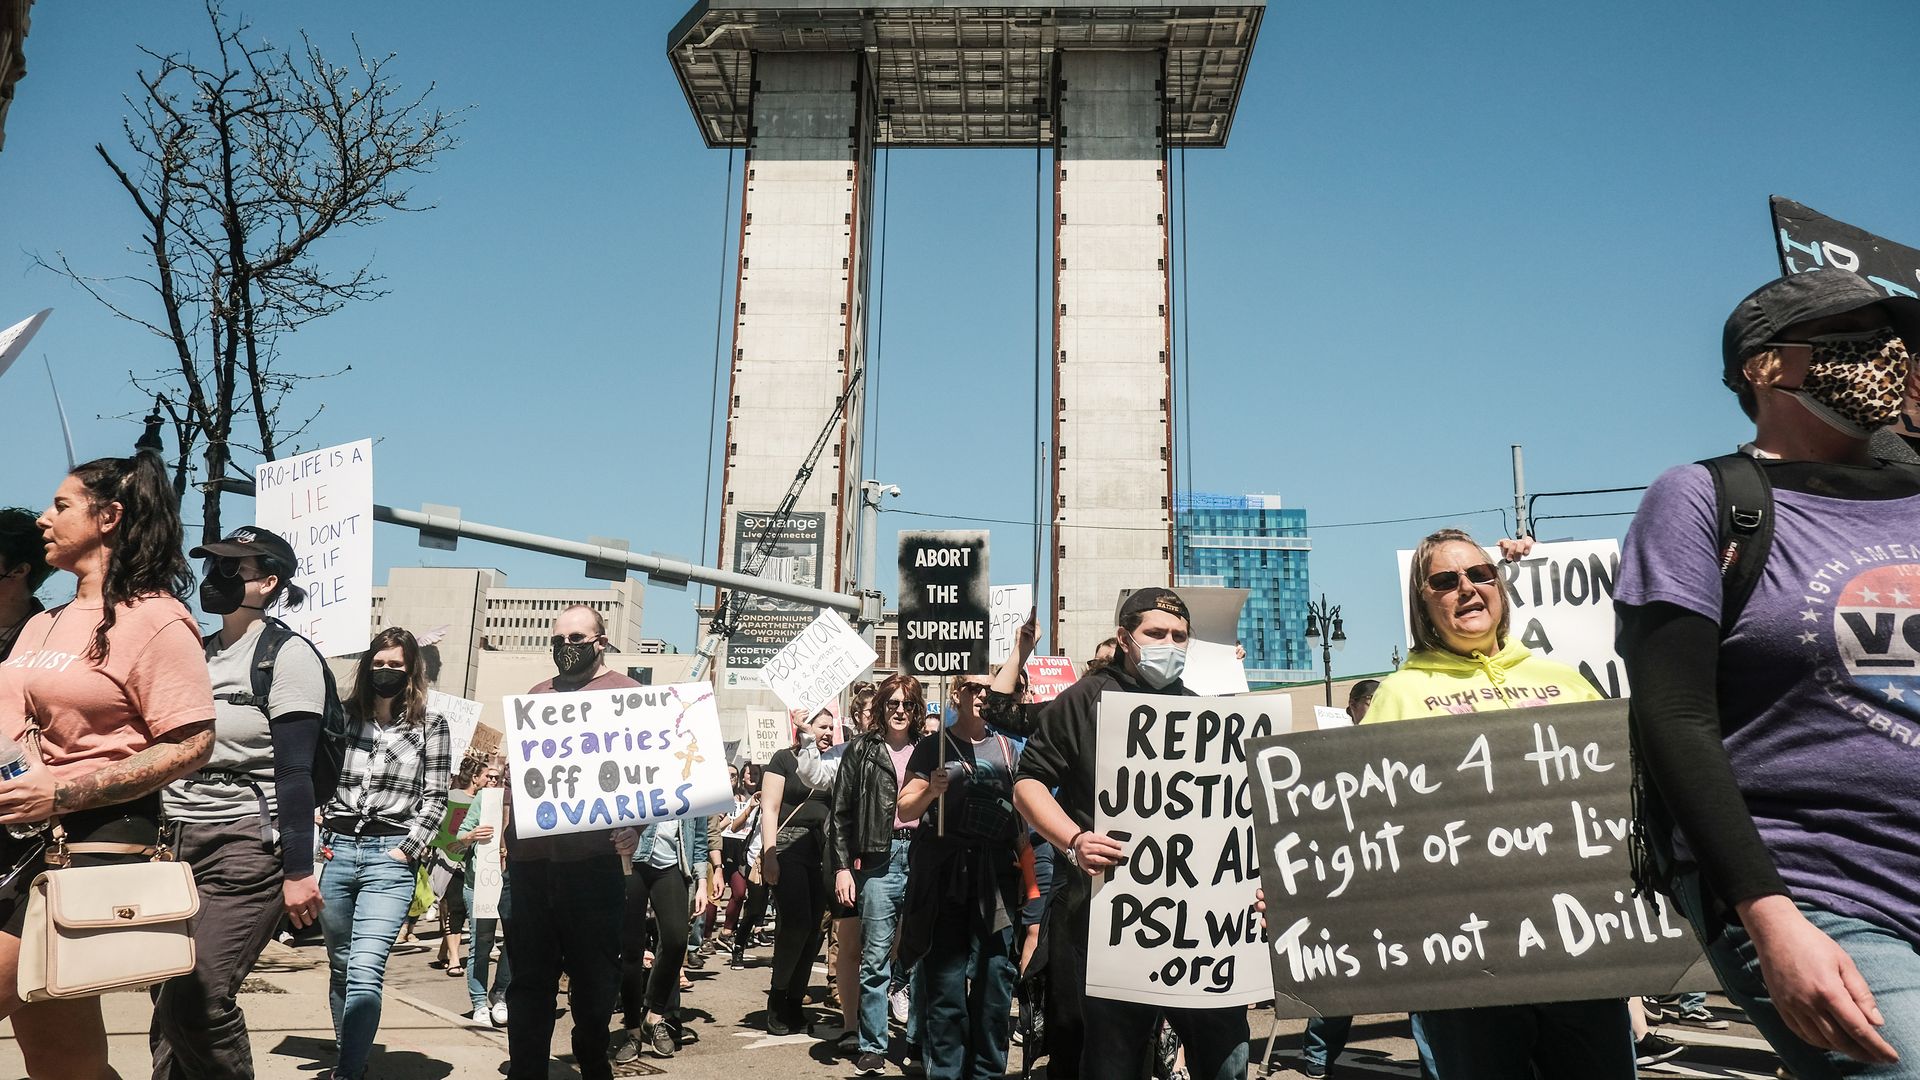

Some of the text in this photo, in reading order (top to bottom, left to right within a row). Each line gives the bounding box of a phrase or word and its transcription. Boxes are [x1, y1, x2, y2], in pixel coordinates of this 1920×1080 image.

[259, 448, 363, 491] PRO-LIFE IS A
[291, 485, 329, 519] LIE
[310, 514, 360, 546] DON'T
[744, 517, 818, 531] exchange
[296, 547, 340, 577] RE IF
[915, 548, 971, 567] ABORT
[926, 585, 959, 604] THE
[1496, 551, 1622, 608] RTION
[1804, 558, 1851, 604] 19TH
[737, 615, 814, 623] CONDOMINIUMS
[907, 620, 984, 640] SUPREME
[765, 614, 842, 689] ABORTION
[1521, 617, 1554, 655] A
[914, 651, 971, 672] COURT
[1039, 667, 1062, 676] BODY
[1046, 658, 1070, 666] YOUR
[611, 691, 671, 716] your
[1033, 683, 1051, 695] NOT
[1424, 685, 1560, 711] RUTH SENT US
[756, 730, 778, 740] BODY
[757, 718, 776, 729] HER
[521, 727, 671, 762] rosaries
[759, 741, 776, 749] HER
[1457, 733, 1494, 794] 4
[1525, 723, 1615, 786] the
[524, 760, 660, 799] Off Our
[1099, 766, 1254, 820] JUSTIC
[536, 783, 693, 830] OVARIES
[1104, 825, 1261, 888] FOR AL
[1274, 821, 1404, 898] Fight
[1487, 822, 1553, 857] our
[1571, 800, 1634, 859] Liv
[1373, 928, 1408, 971] is
[1423, 912, 1489, 965] not
[1518, 917, 1547, 958] A
[1149, 955, 1235, 993] .org
